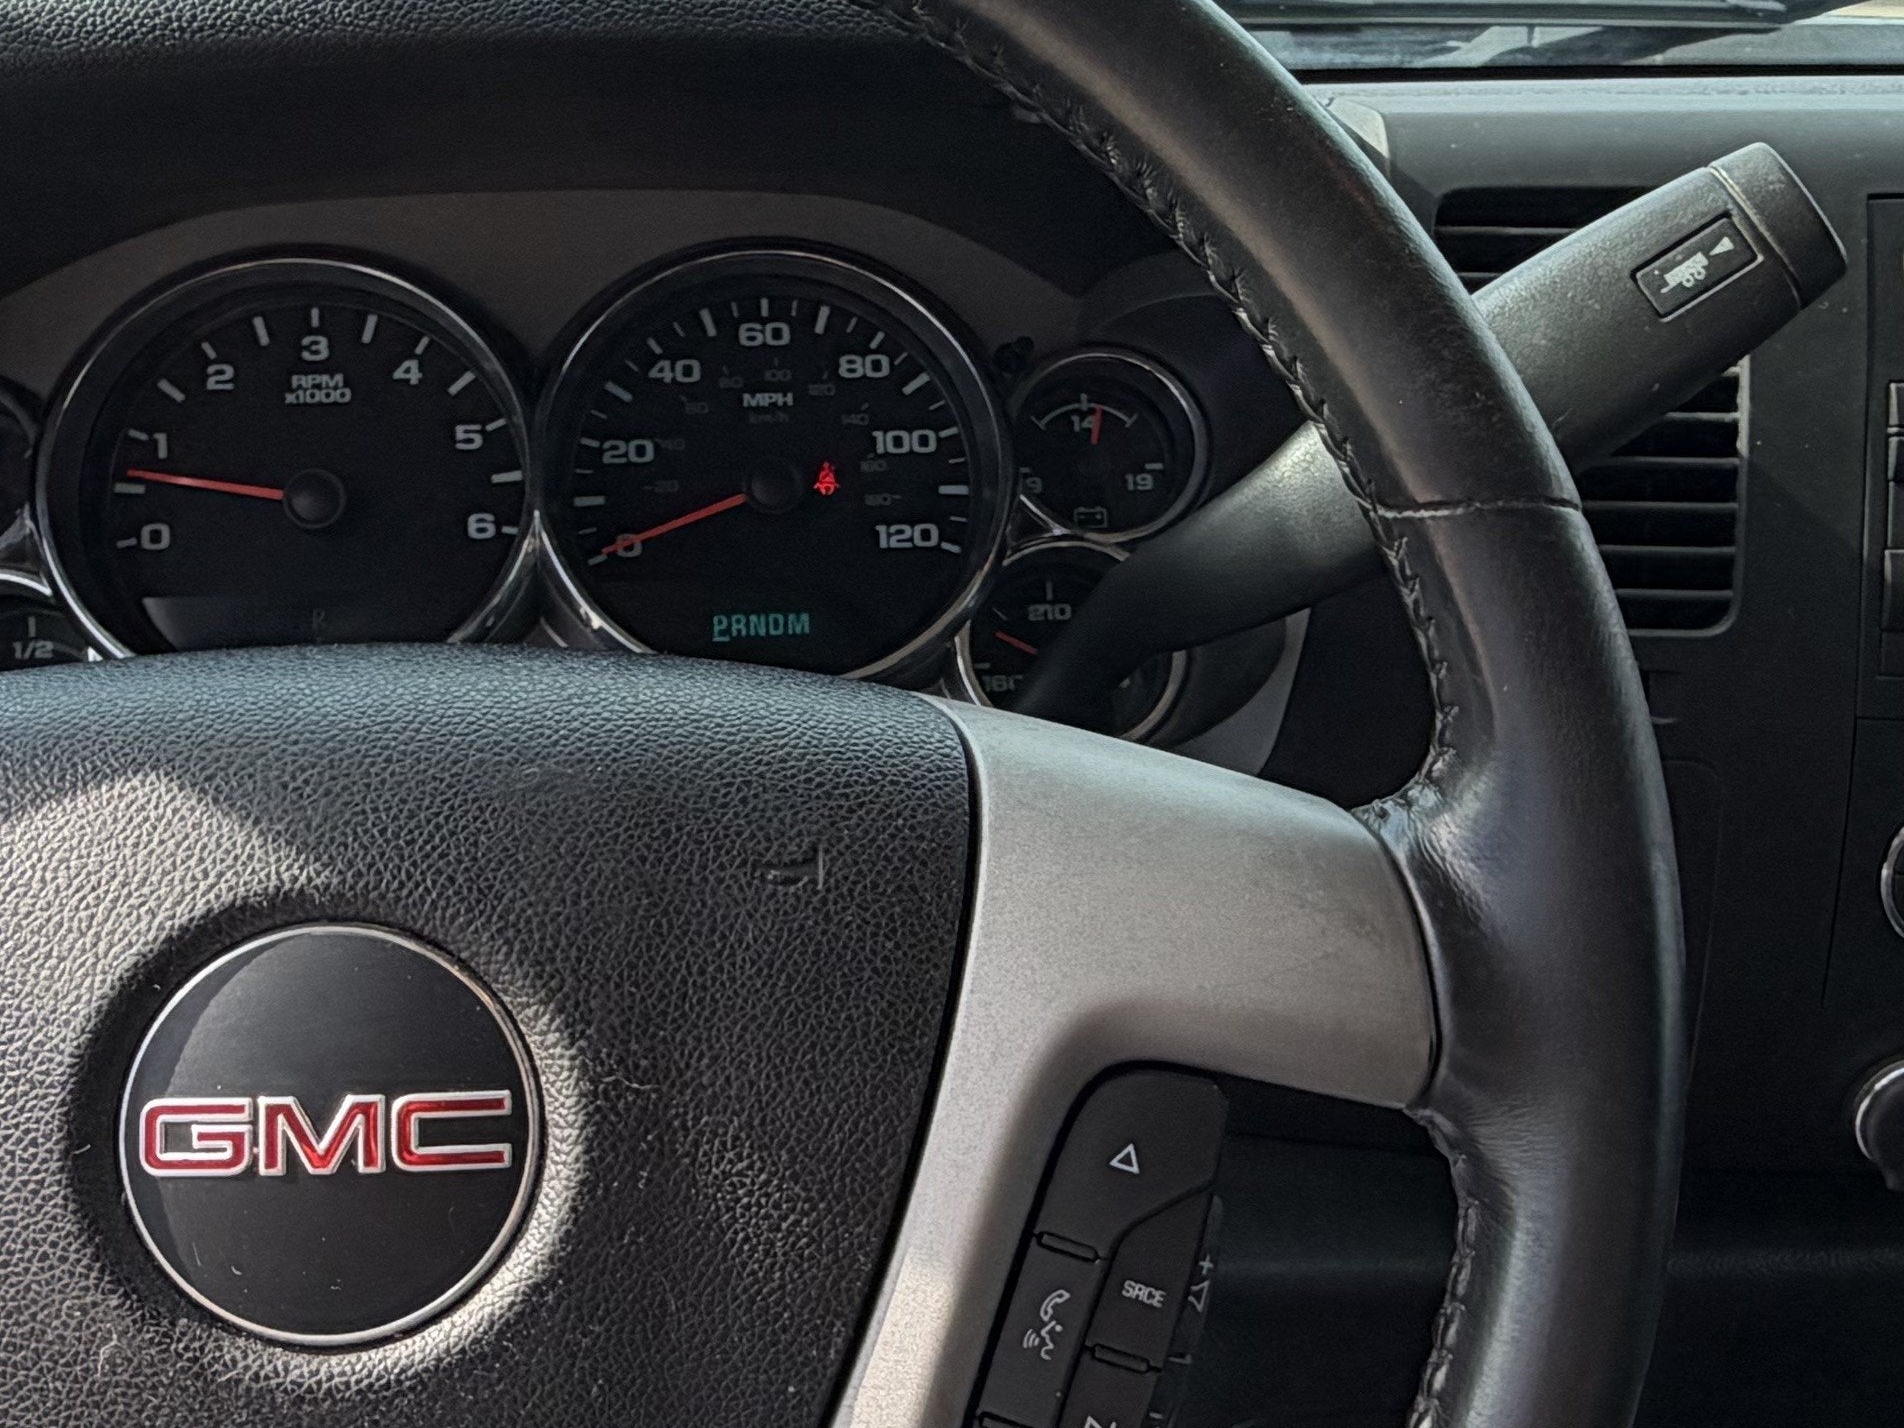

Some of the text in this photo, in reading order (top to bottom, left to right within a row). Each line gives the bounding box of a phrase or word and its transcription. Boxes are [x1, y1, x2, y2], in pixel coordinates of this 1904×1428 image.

[300, 334, 331, 362] 3
[737, 322, 792, 348] 60
[205, 362, 235, 391] 2
[391, 358, 424, 386] 4
[647, 358, 702, 385] 40
[837, 353, 891, 379] 80
[290, 373, 345, 390] RPM
[284, 387, 352, 405] x1000
[742, 391, 794, 408] MPH
[153, 431, 169, 460] 1
[453, 423, 484, 451] 5
[870, 429, 938, 455] 100
[600, 438, 655, 465] 20
[1024, 476, 1044, 494] 9
[1124, 473, 1155, 492] 19
[140, 522, 172, 551] 0
[465, 512, 497, 540] 6
[874, 522, 940, 550] 120
[614, 532, 643, 559] 0
[711, 612, 811, 641] PRNDM
[12, 640, 54, 660] 1/2
[138, 1089, 513, 1179] GMC
[1121, 1280, 1165, 1308] SRCE
